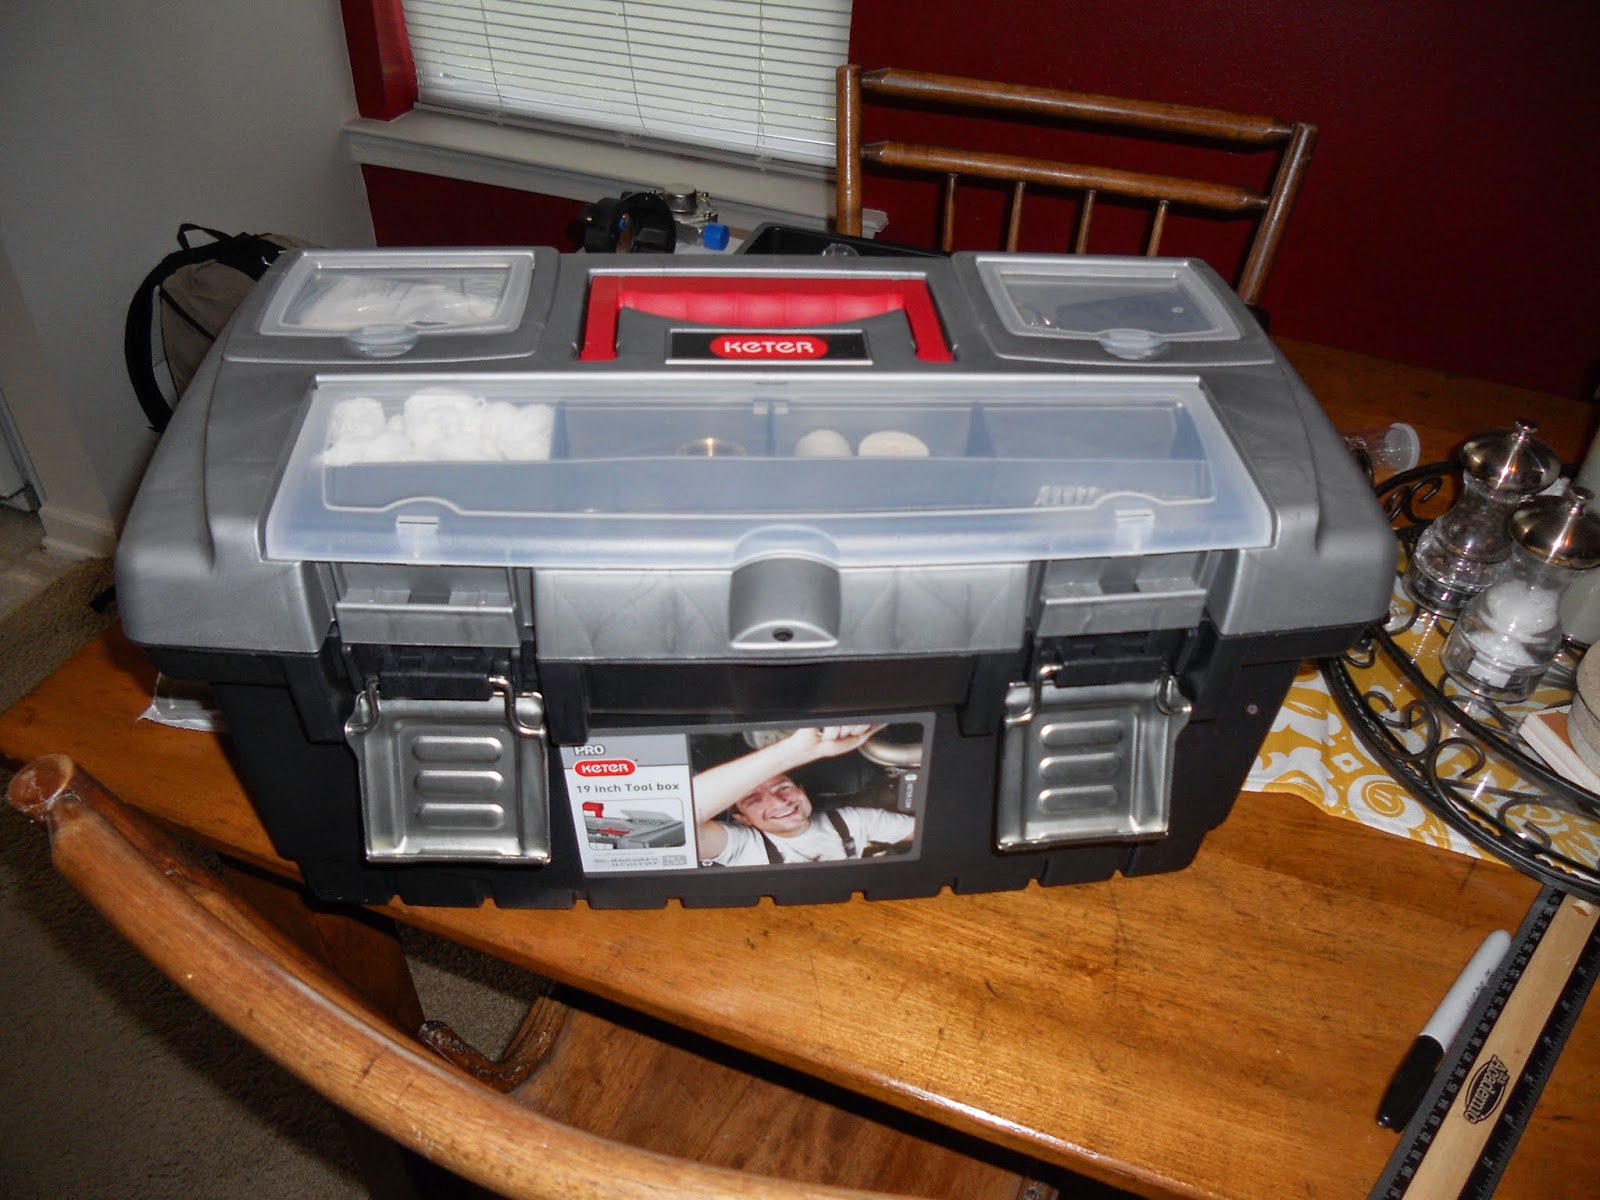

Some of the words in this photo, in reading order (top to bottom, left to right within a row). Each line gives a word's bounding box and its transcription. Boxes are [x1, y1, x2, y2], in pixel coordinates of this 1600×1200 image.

[574, 744, 605, 756] PRO
[577, 785, 590, 793] 19
[595, 784, 621, 792] inch
[625, 783, 653, 791] Tool
[657, 782, 679, 790] box
[1462, 1056, 1509, 1124] Academic
